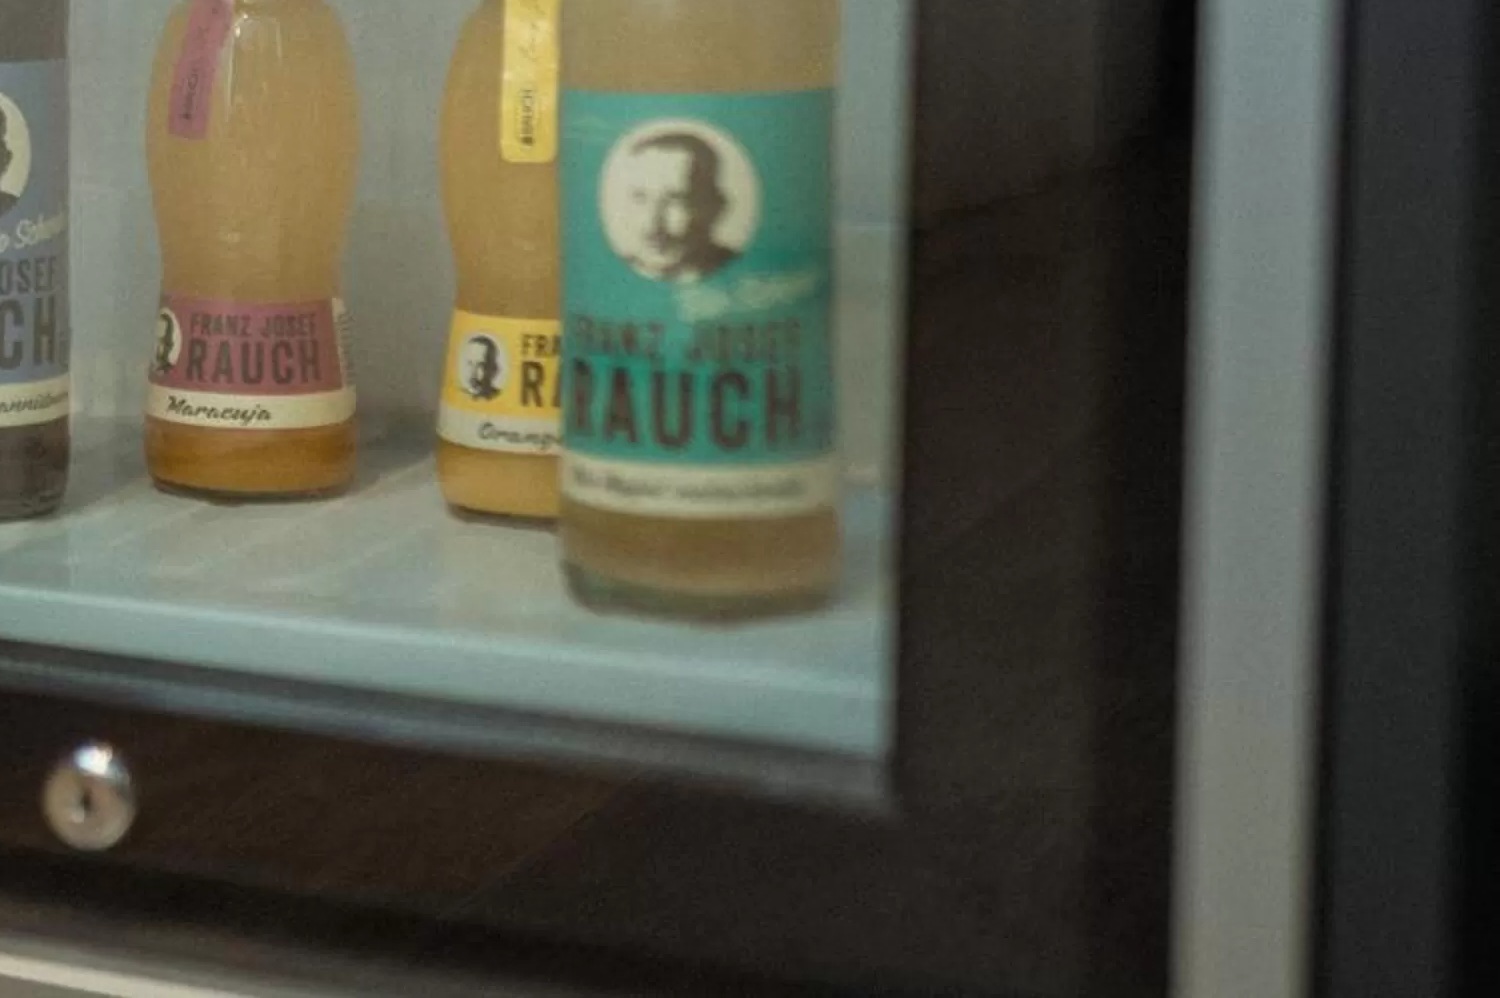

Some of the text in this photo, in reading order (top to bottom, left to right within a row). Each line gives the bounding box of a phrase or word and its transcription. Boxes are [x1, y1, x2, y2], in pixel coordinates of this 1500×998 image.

[190, 313, 318, 339] FRANZ JOSEF
[185, 337, 322, 386] RAUCH
[167, 395, 272, 426] Maracuja
[571, 356, 803, 450] RAUCH
